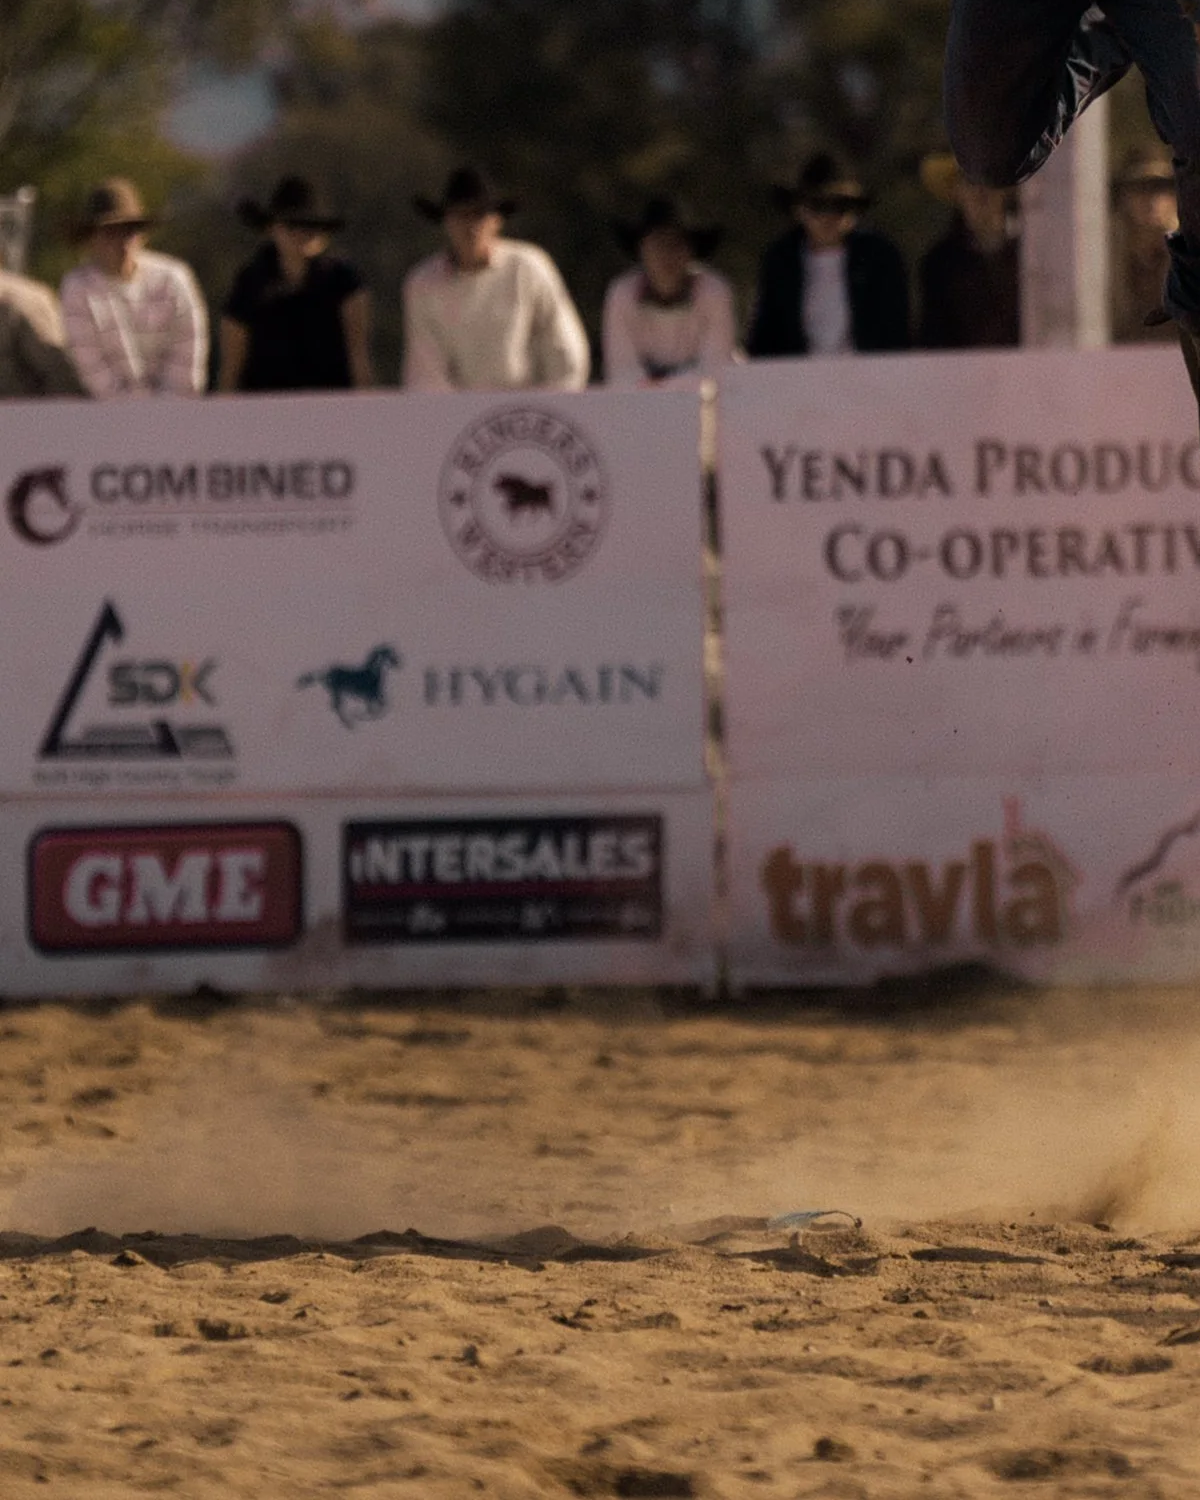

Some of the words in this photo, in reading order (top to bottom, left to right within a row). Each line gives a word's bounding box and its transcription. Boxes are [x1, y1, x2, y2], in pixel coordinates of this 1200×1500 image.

[89, 459, 356, 503] COMBINED
[107, 658, 218, 706] SDK
[422, 660, 664, 705] HYGAIN
[63, 847, 267, 926] GME
[759, 838, 1063, 946] travla
